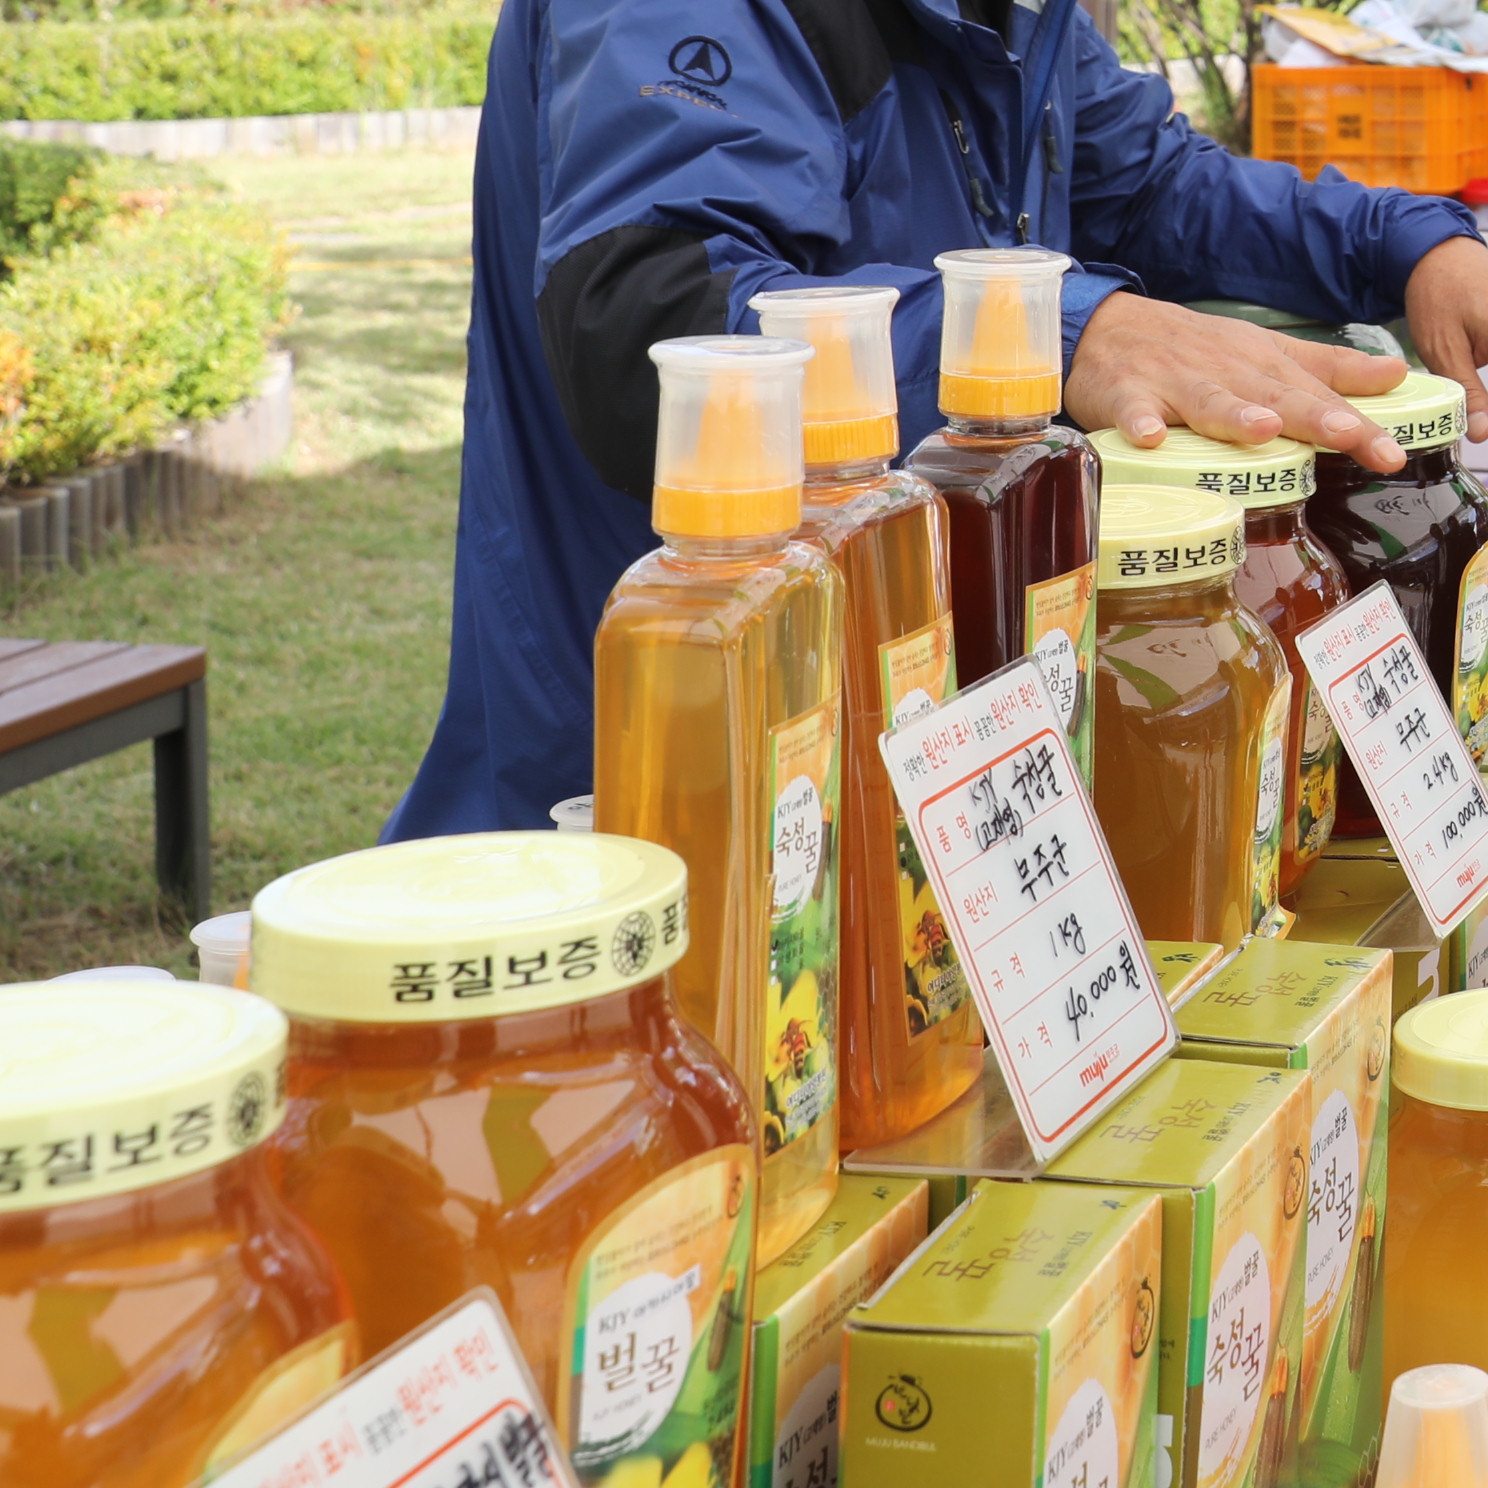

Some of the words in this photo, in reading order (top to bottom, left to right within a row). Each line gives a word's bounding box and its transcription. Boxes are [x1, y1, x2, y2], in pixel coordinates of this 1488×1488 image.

[1387, 412, 1453, 445] 질보증
[1195, 467, 1297, 496] 품질보증
[1117, 537, 1228, 576] 품질보증
[1043, 663, 1074, 713] 성꿀
[903, 751, 929, 782] 정확한
[922, 724, 955, 771] 원산지
[952, 715, 975, 747] 표시
[990, 692, 1023, 731] 원산지
[1019, 678, 1044, 713] 확인
[1365, 740, 1388, 771] 원산지
[1395, 707, 1431, 753] 무주군
[1011, 744, 1063, 815] 숙성꿀
[1260, 767, 1280, 810] 숙성꿀
[776, 816, 818, 875] 숙성꿀
[963, 880, 999, 923] 원산지
[1014, 833, 1071, 901] 무주군
[390, 935, 602, 1003] 품질보증
[1203, 970, 1307, 1008] 숙성꿀
[1079, 1050, 1109, 1088] muju
[1099, 1098, 1217, 1144] 숙성꿀
[1334, 1105, 1349, 1138] 벌꿀
[1307, 1156, 1355, 1243] 숙성꿀
[922, 1227, 1054, 1283] 숙성꿀
[1211, 1286, 1229, 1322] KJY
[1243, 1249, 1261, 1285] 벌꿀
[598, 1315, 629, 1335] KJY
[598, 1332, 681, 1394] 벌꿀
[1206, 1306, 1265, 1404] 숙성꿀
[777, 1423, 803, 1471] KJY
[1047, 1438, 1068, 1486] KJY
[1085, 1393, 1105, 1431] 벌꿀
